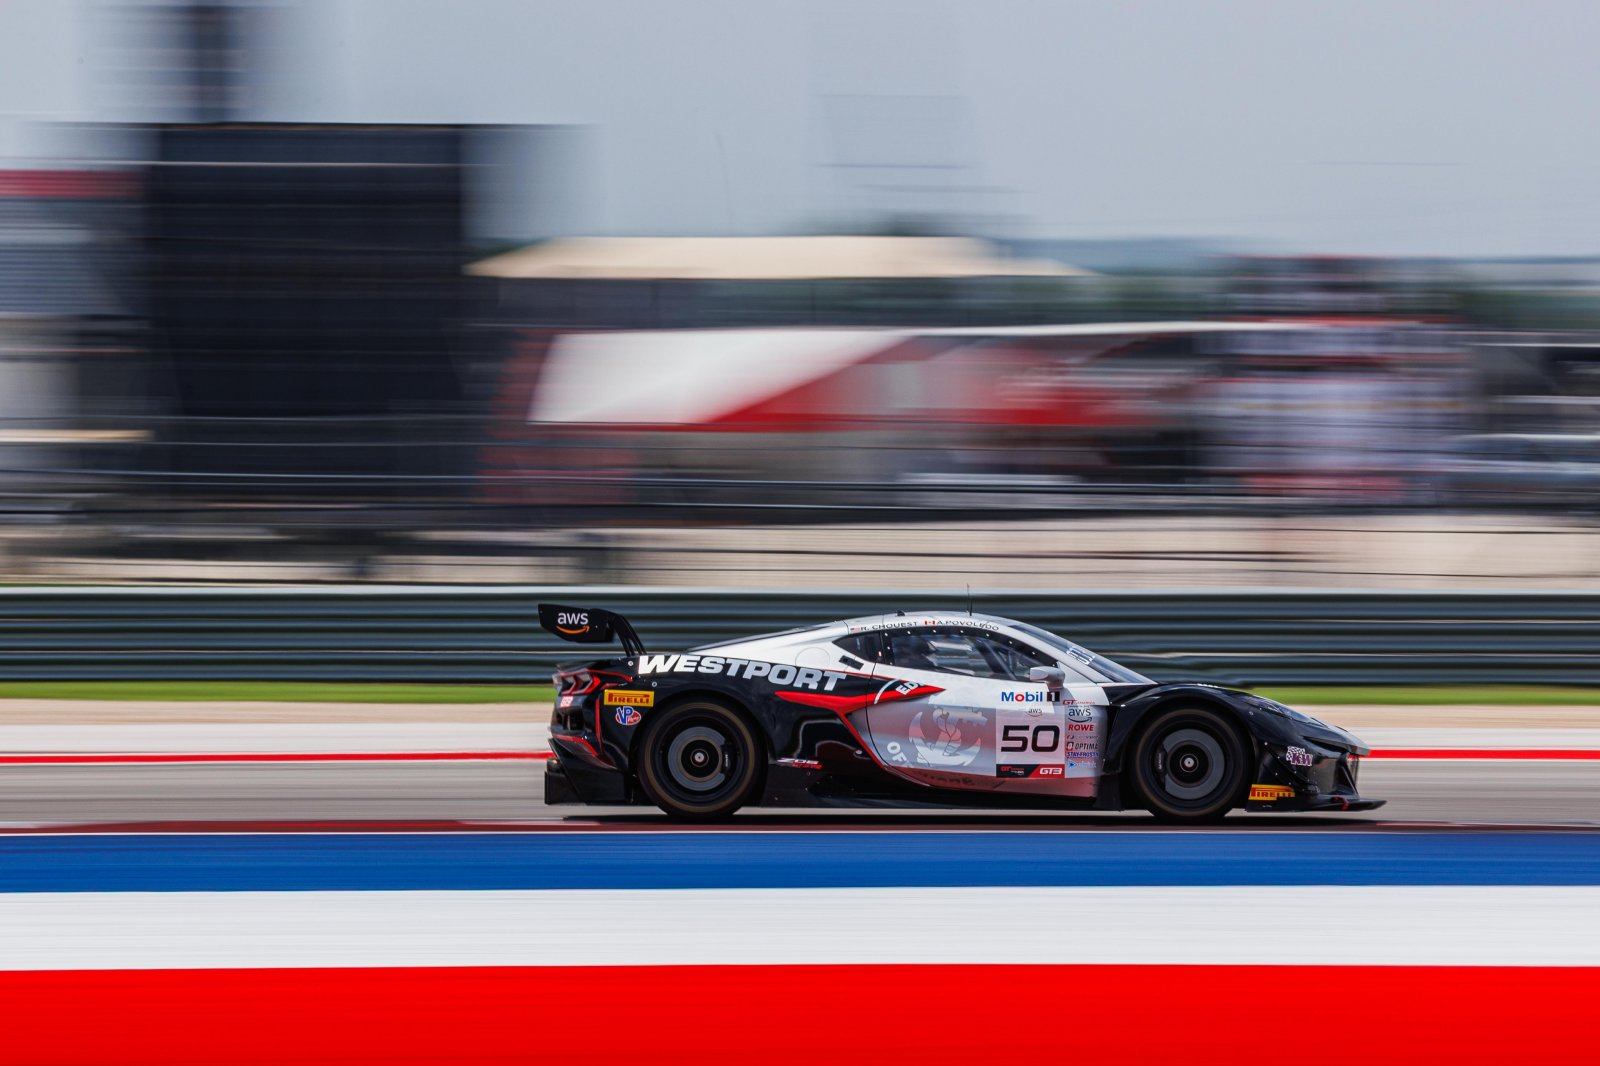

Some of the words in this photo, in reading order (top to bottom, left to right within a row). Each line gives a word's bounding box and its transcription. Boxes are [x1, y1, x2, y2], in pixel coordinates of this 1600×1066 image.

[557, 612, 589, 625] aws
[872, 621, 918, 631] CHOUEST
[638, 654, 847, 692] WESTPORT
[608, 693, 650, 704] PIRELLI
[1001, 691, 1043, 702] Mobil
[616, 706, 635, 725] VP
[1068, 708, 1092, 717] aws
[1068, 724, 1095, 732] ROWE
[1001, 725, 1060, 752] 50
[1040, 767, 1062, 775] GT3
